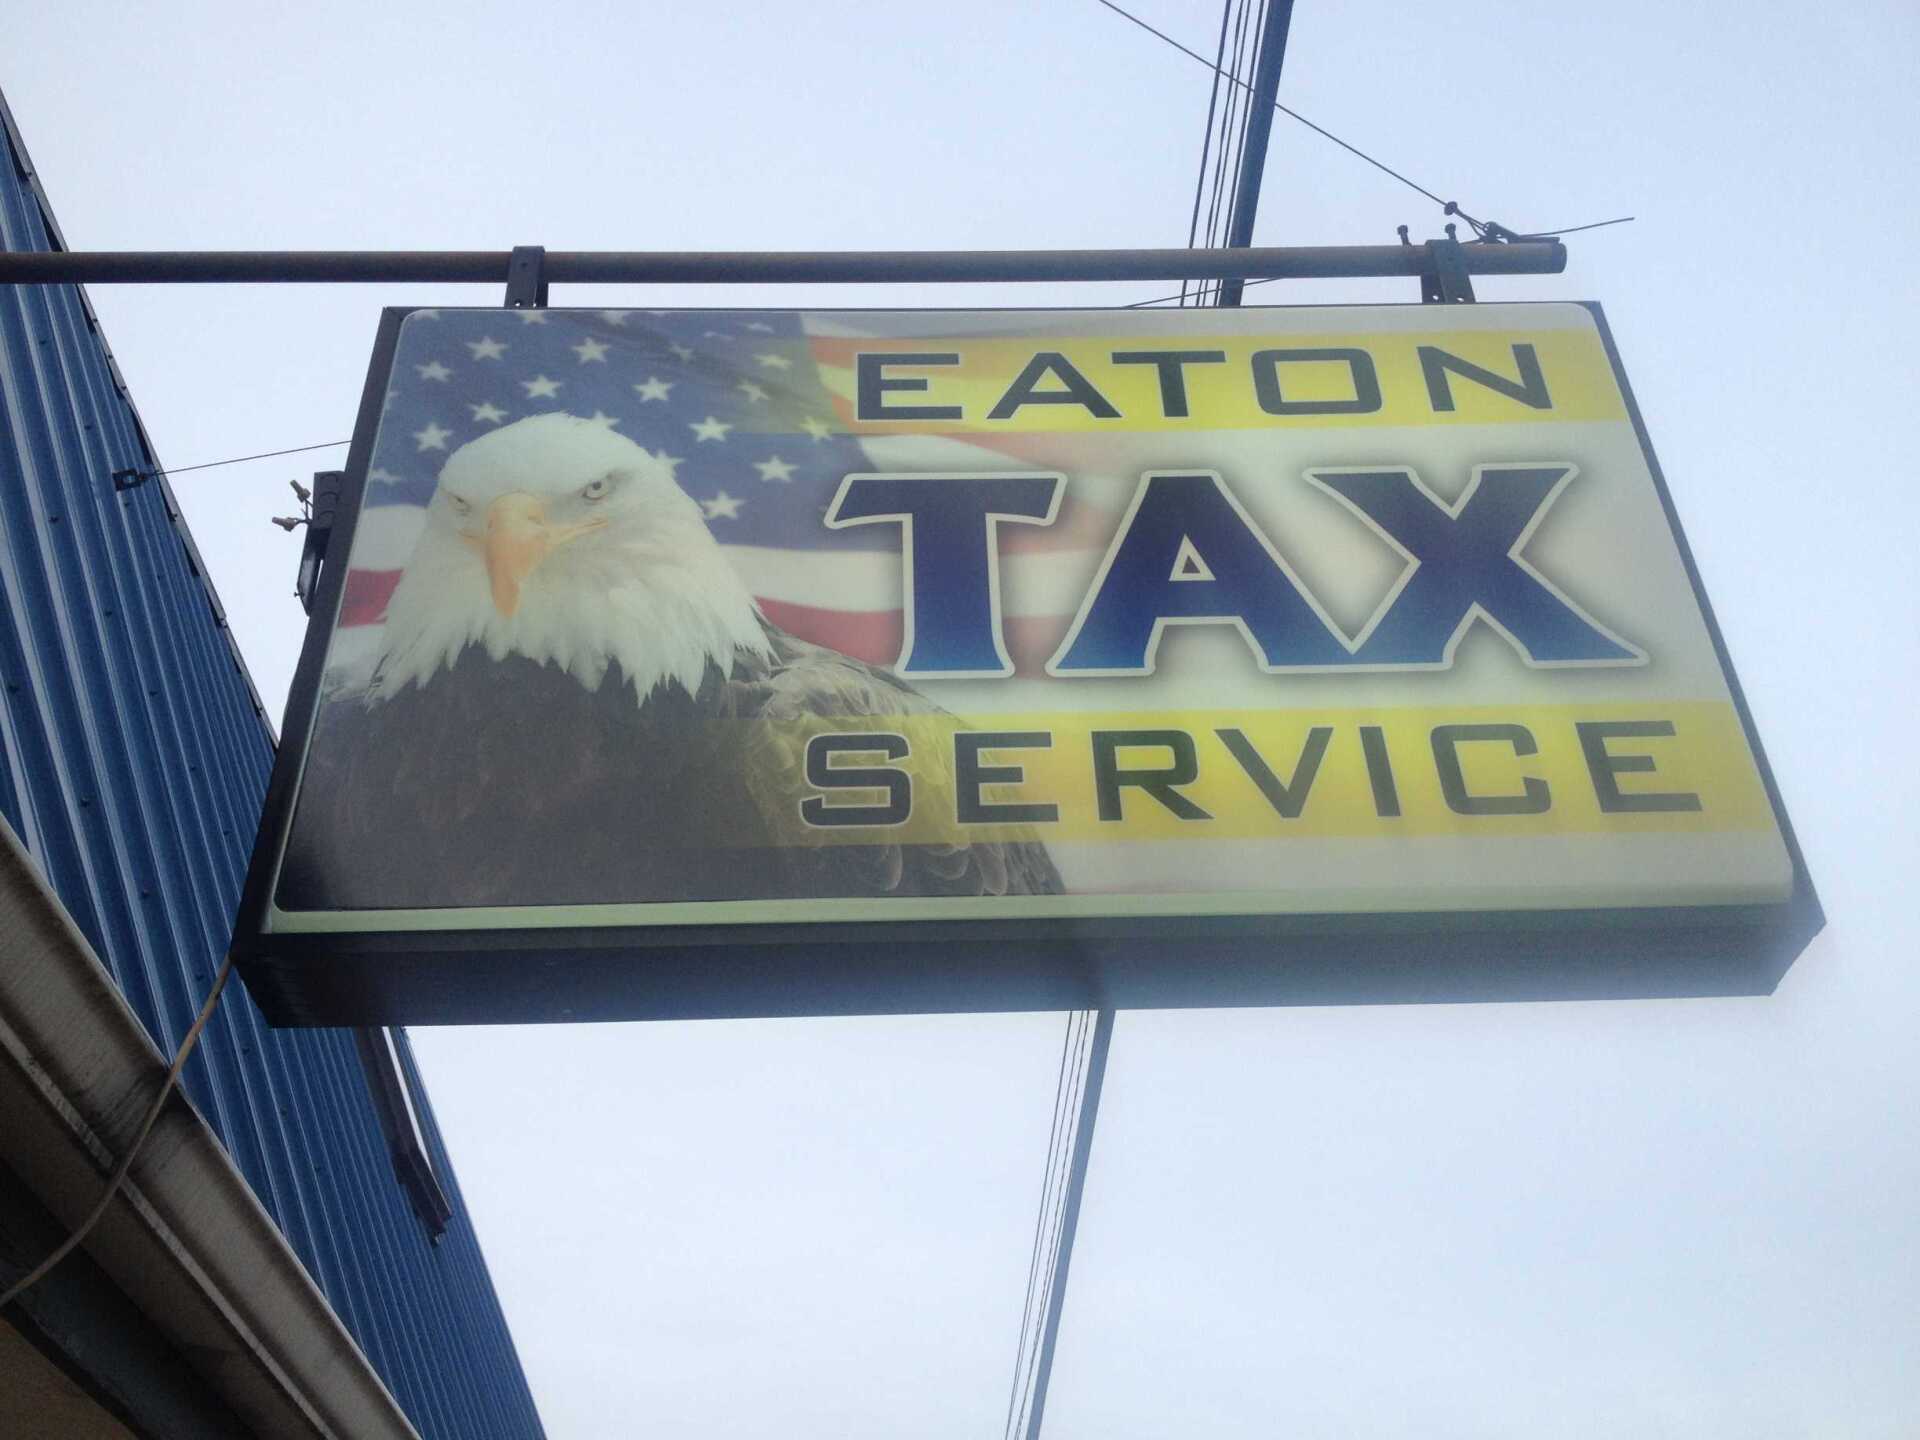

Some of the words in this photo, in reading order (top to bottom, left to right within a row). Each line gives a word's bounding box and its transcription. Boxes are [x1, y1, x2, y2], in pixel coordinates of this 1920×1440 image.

[857, 343, 1553, 421] EATON
[824, 462, 1650, 678] TAX
[801, 720, 1702, 829] SERVICE
